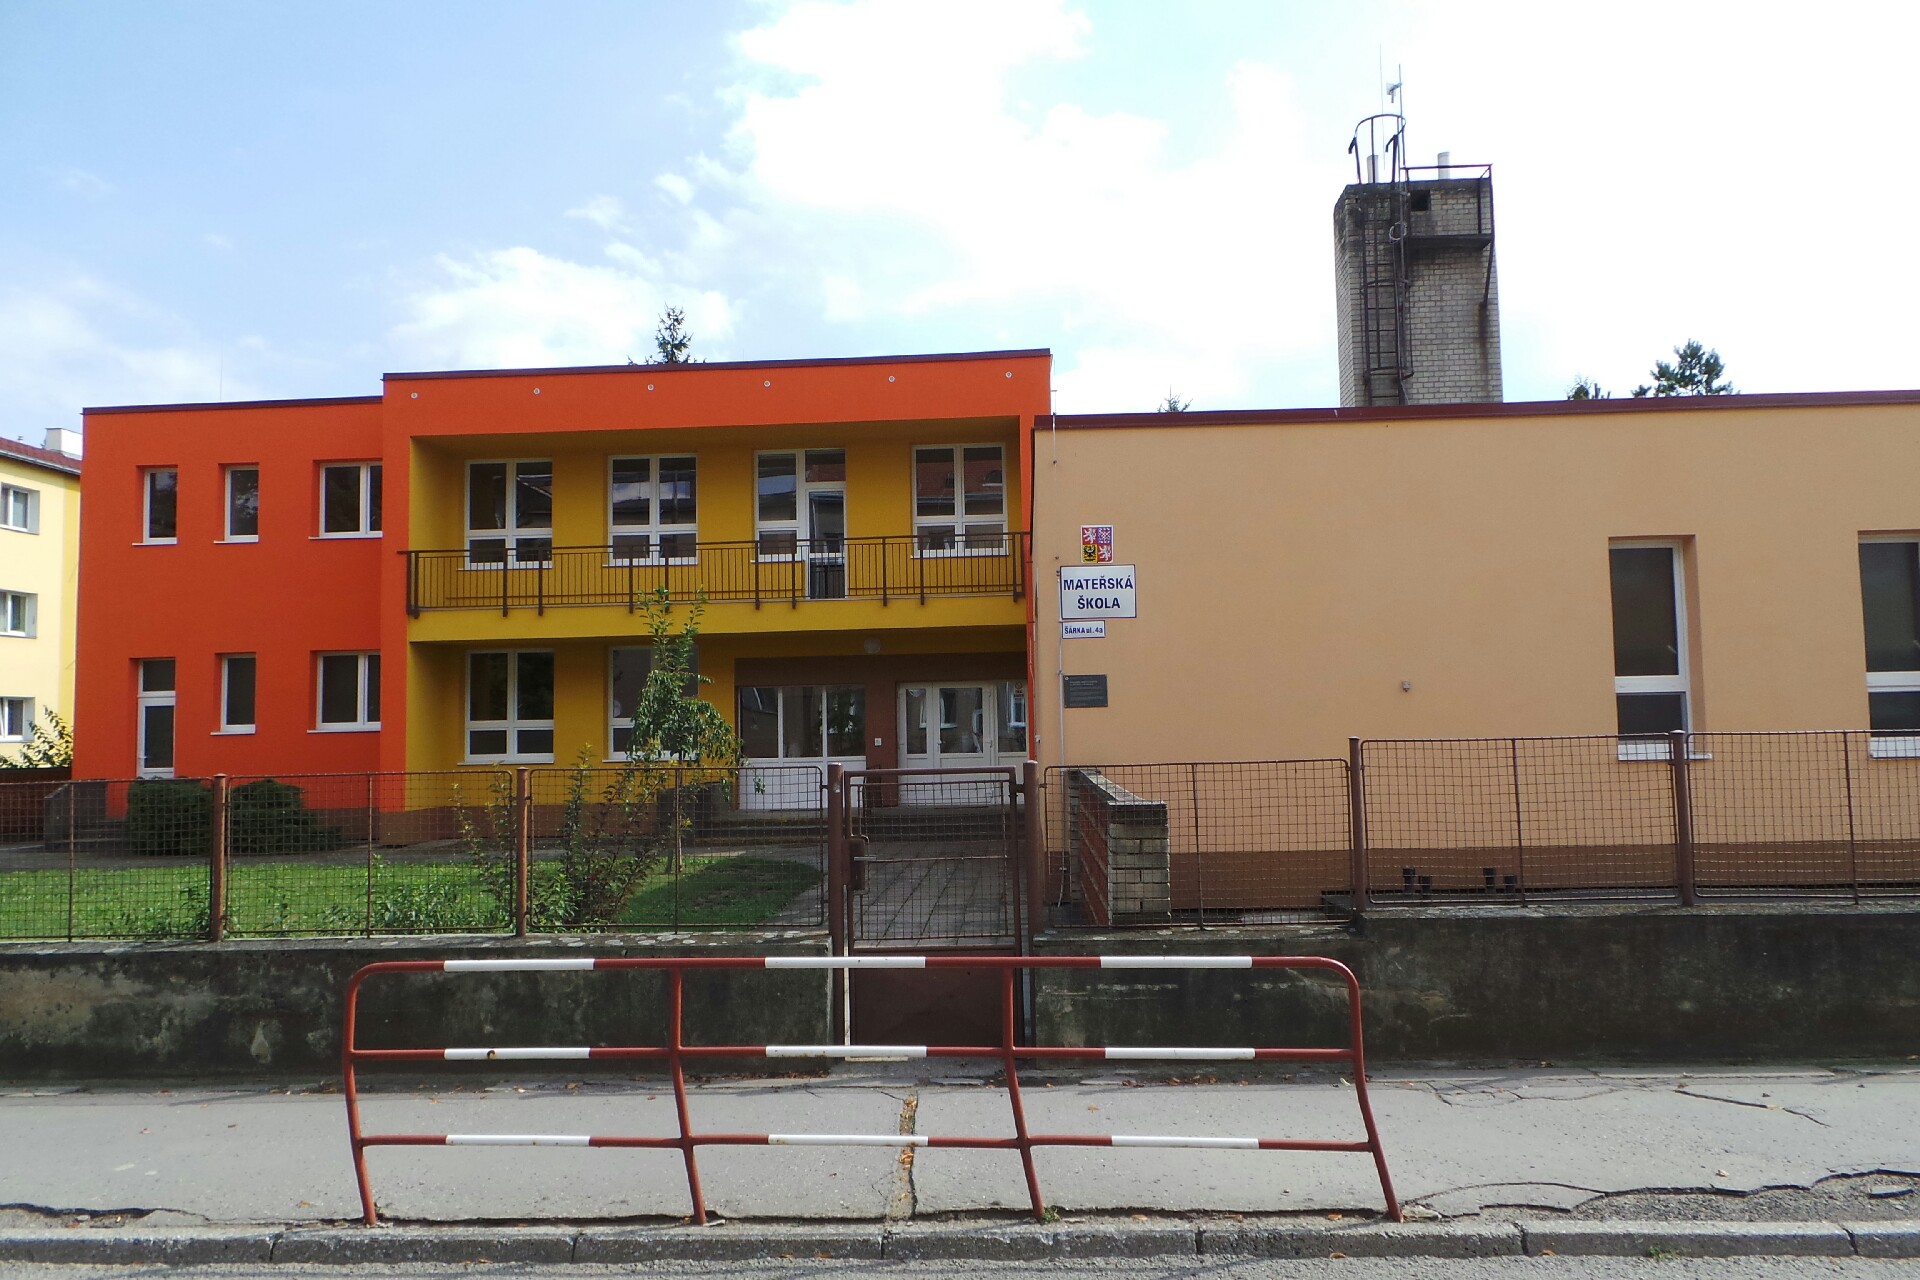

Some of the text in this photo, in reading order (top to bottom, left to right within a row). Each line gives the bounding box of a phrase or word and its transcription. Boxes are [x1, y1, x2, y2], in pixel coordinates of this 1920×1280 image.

[1063, 575, 1133, 590] MATEŘSKÁ
[1077, 595, 1120, 609] ŠKOLA
[1064, 626, 1085, 634] ŠÁRKA
